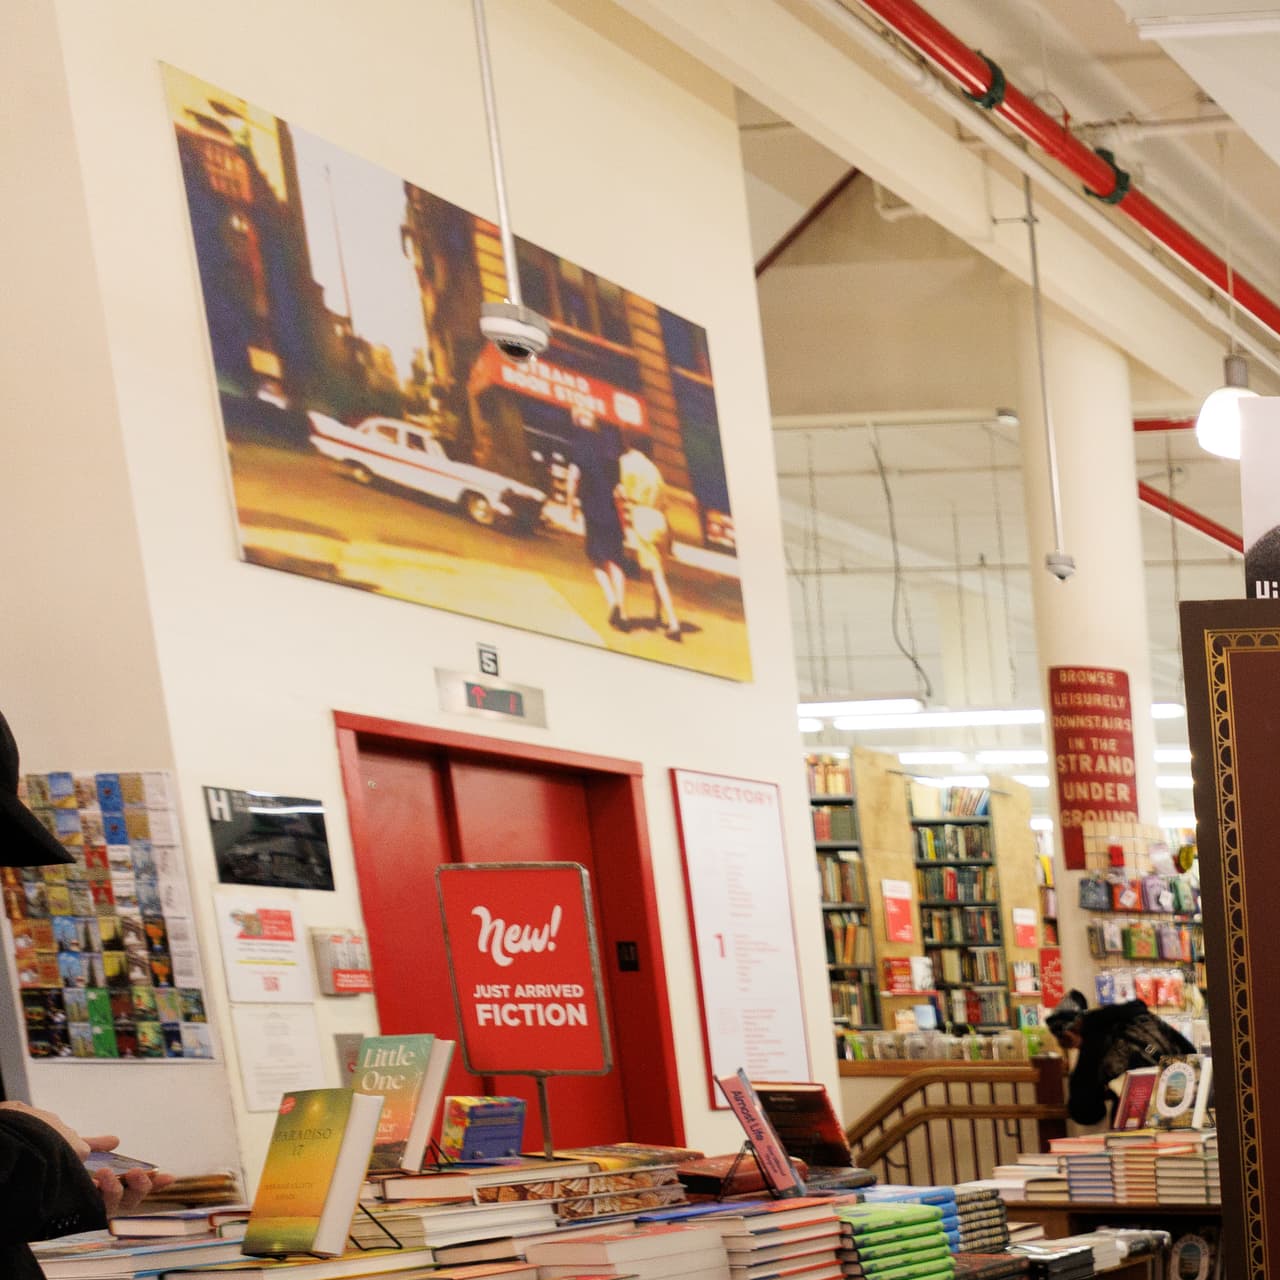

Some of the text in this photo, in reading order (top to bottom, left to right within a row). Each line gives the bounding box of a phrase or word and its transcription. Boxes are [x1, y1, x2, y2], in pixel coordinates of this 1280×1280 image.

[1059, 670, 1116, 685] BROWSE
[1054, 692, 1126, 708] LEISURELY
[1068, 737, 1118, 751] IN THE
[1056, 753, 1134, 776] STRAND
[683, 778, 774, 808] DIRECTORY
[1063, 782, 1130, 801] UNDER
[472, 905, 562, 966] New!
[713, 932, 727, 958] 1
[473, 984, 584, 998] JUST ARRIVED
[475, 1003, 588, 1026] FICTION
[364, 1046, 417, 1068] Little
[361, 1071, 406, 1091] One
[730, 1089, 764, 1142] Almost Life
